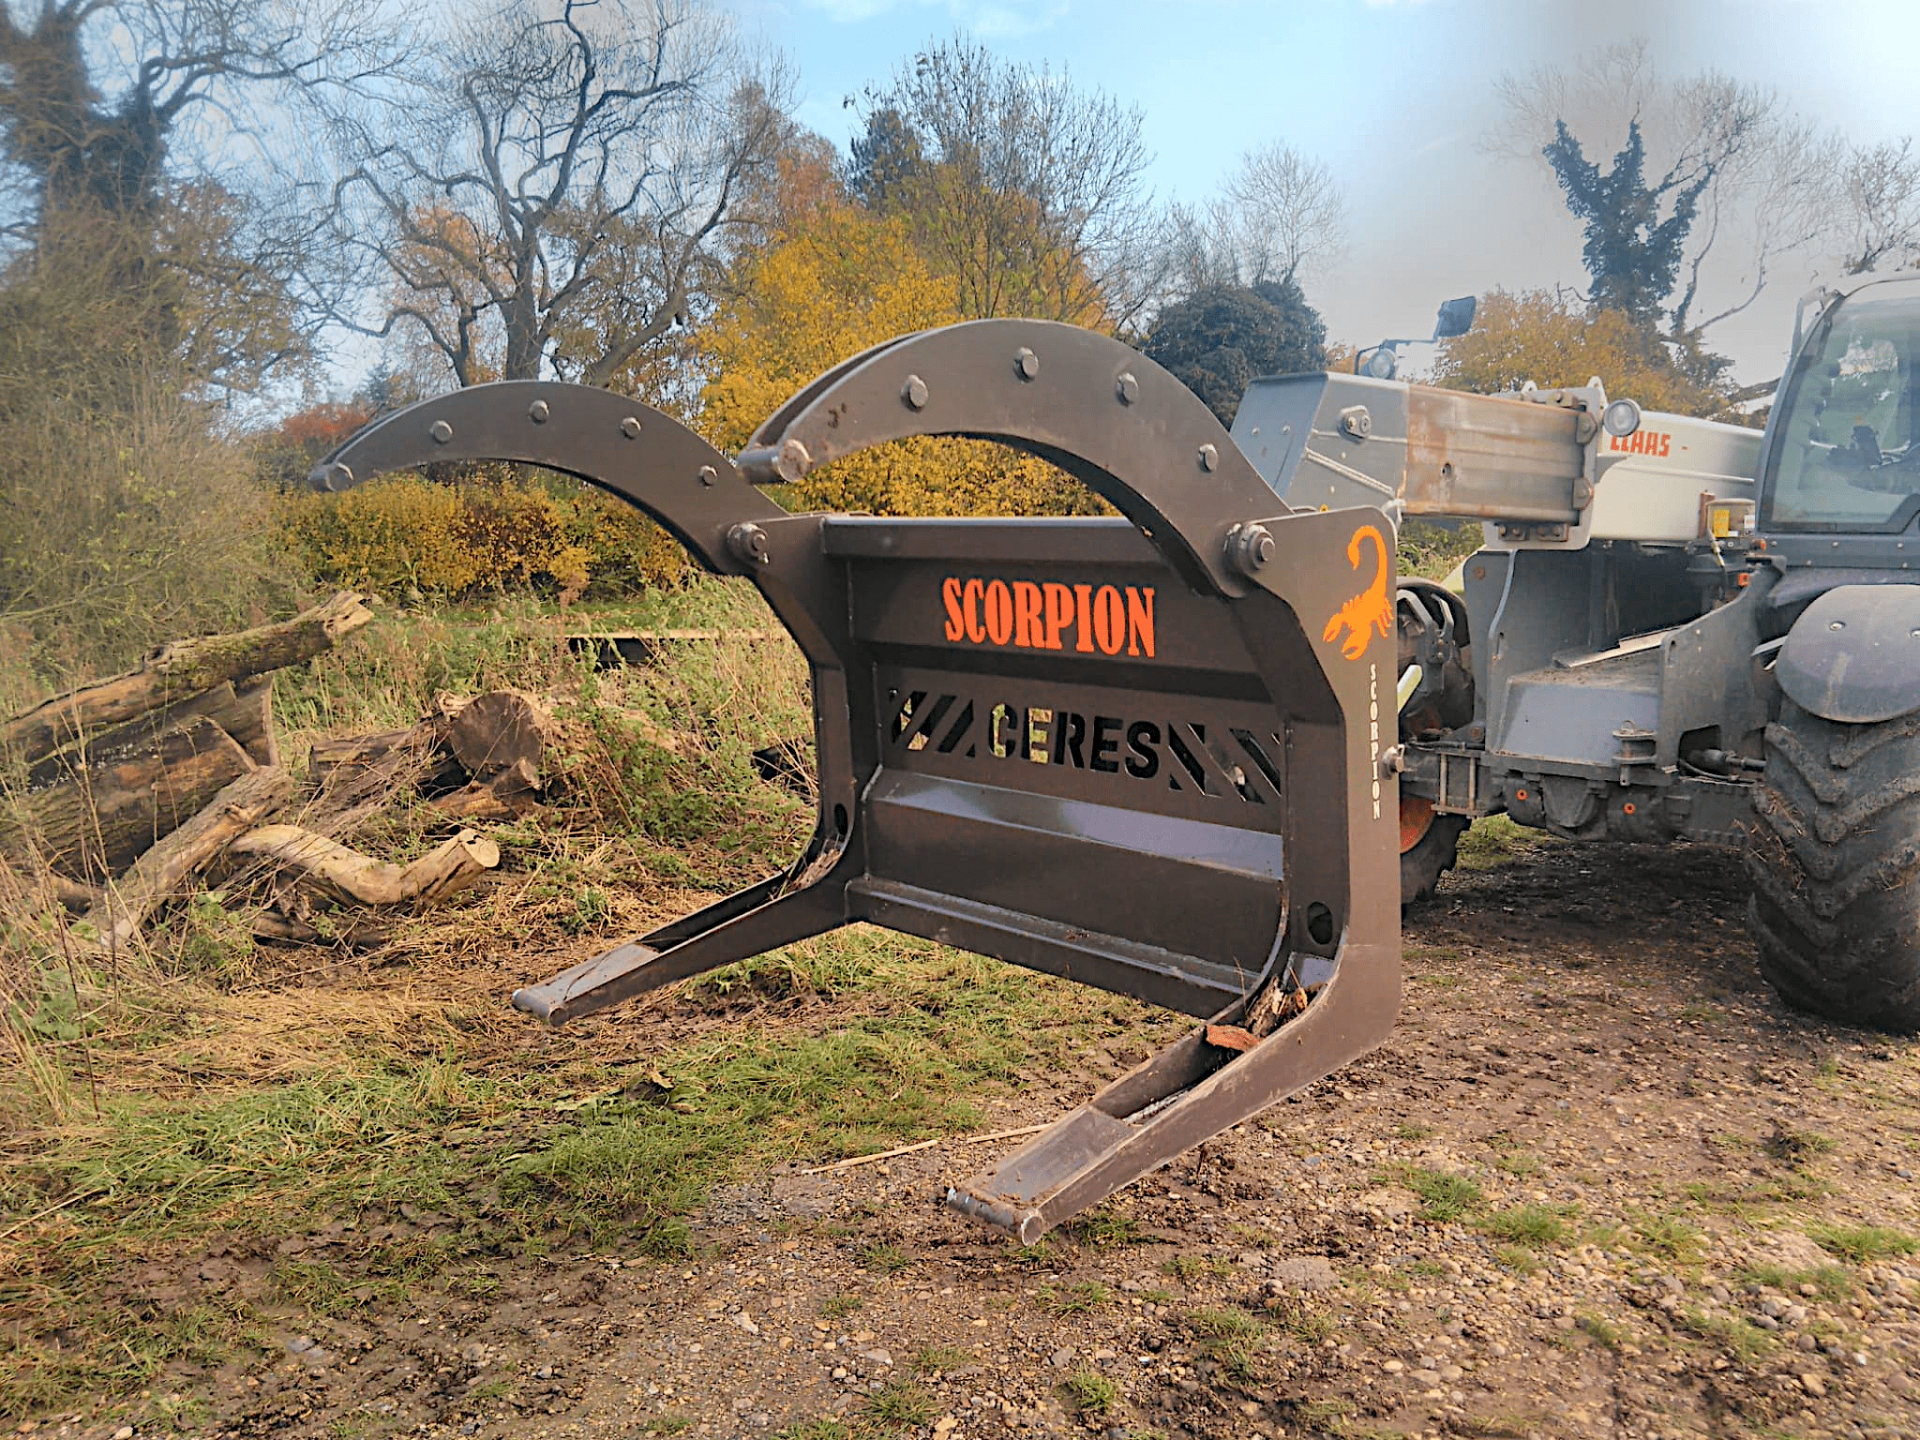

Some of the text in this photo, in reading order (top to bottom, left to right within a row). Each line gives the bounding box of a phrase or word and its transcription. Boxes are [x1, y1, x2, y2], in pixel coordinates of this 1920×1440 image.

[943, 577, 1156, 658] SCORPION
[988, 703, 1161, 779] CERES
[1369, 664, 1381, 820] SCORPION
